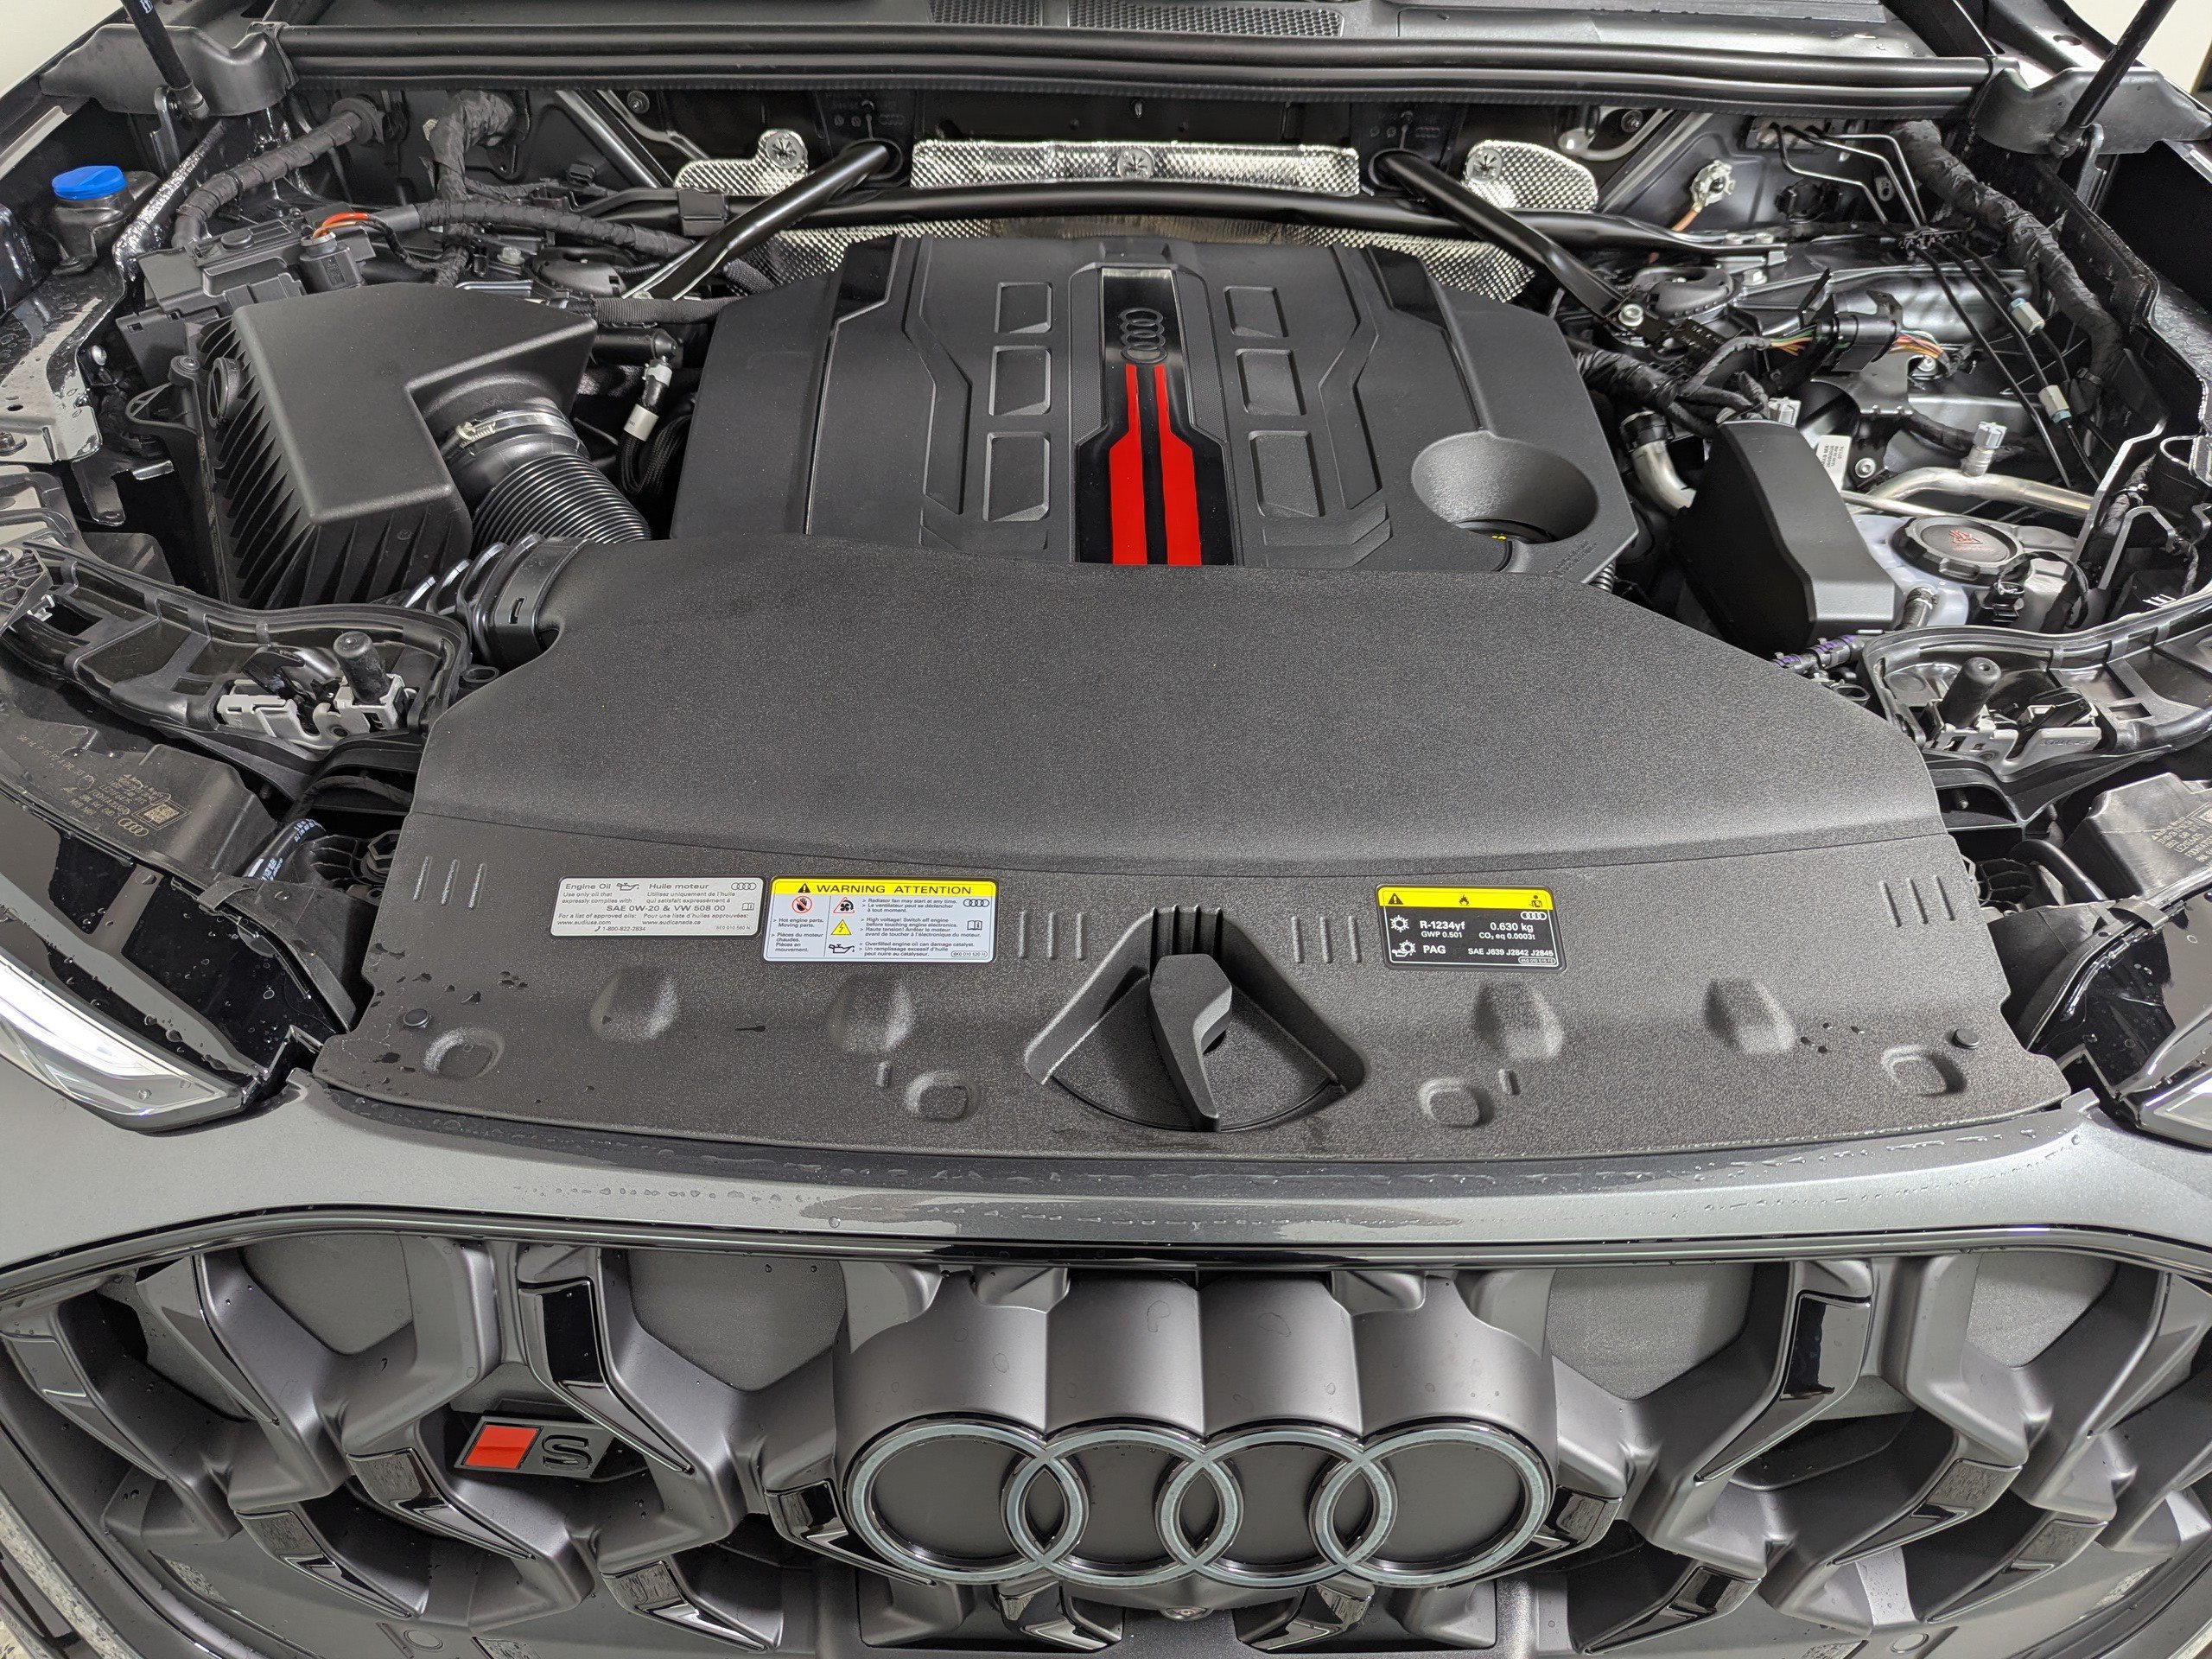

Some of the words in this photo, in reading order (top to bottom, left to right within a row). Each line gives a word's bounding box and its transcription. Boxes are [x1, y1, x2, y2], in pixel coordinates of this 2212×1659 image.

[817, 885, 886, 893] WARNING
[894, 886, 971, 894] ATTENTION
[1420, 920, 1465, 931] R-1234yf
[1490, 922, 1518, 931] 0.630
[1521, 923, 1533, 933] kg
[1423, 945, 1446, 954] PAG
